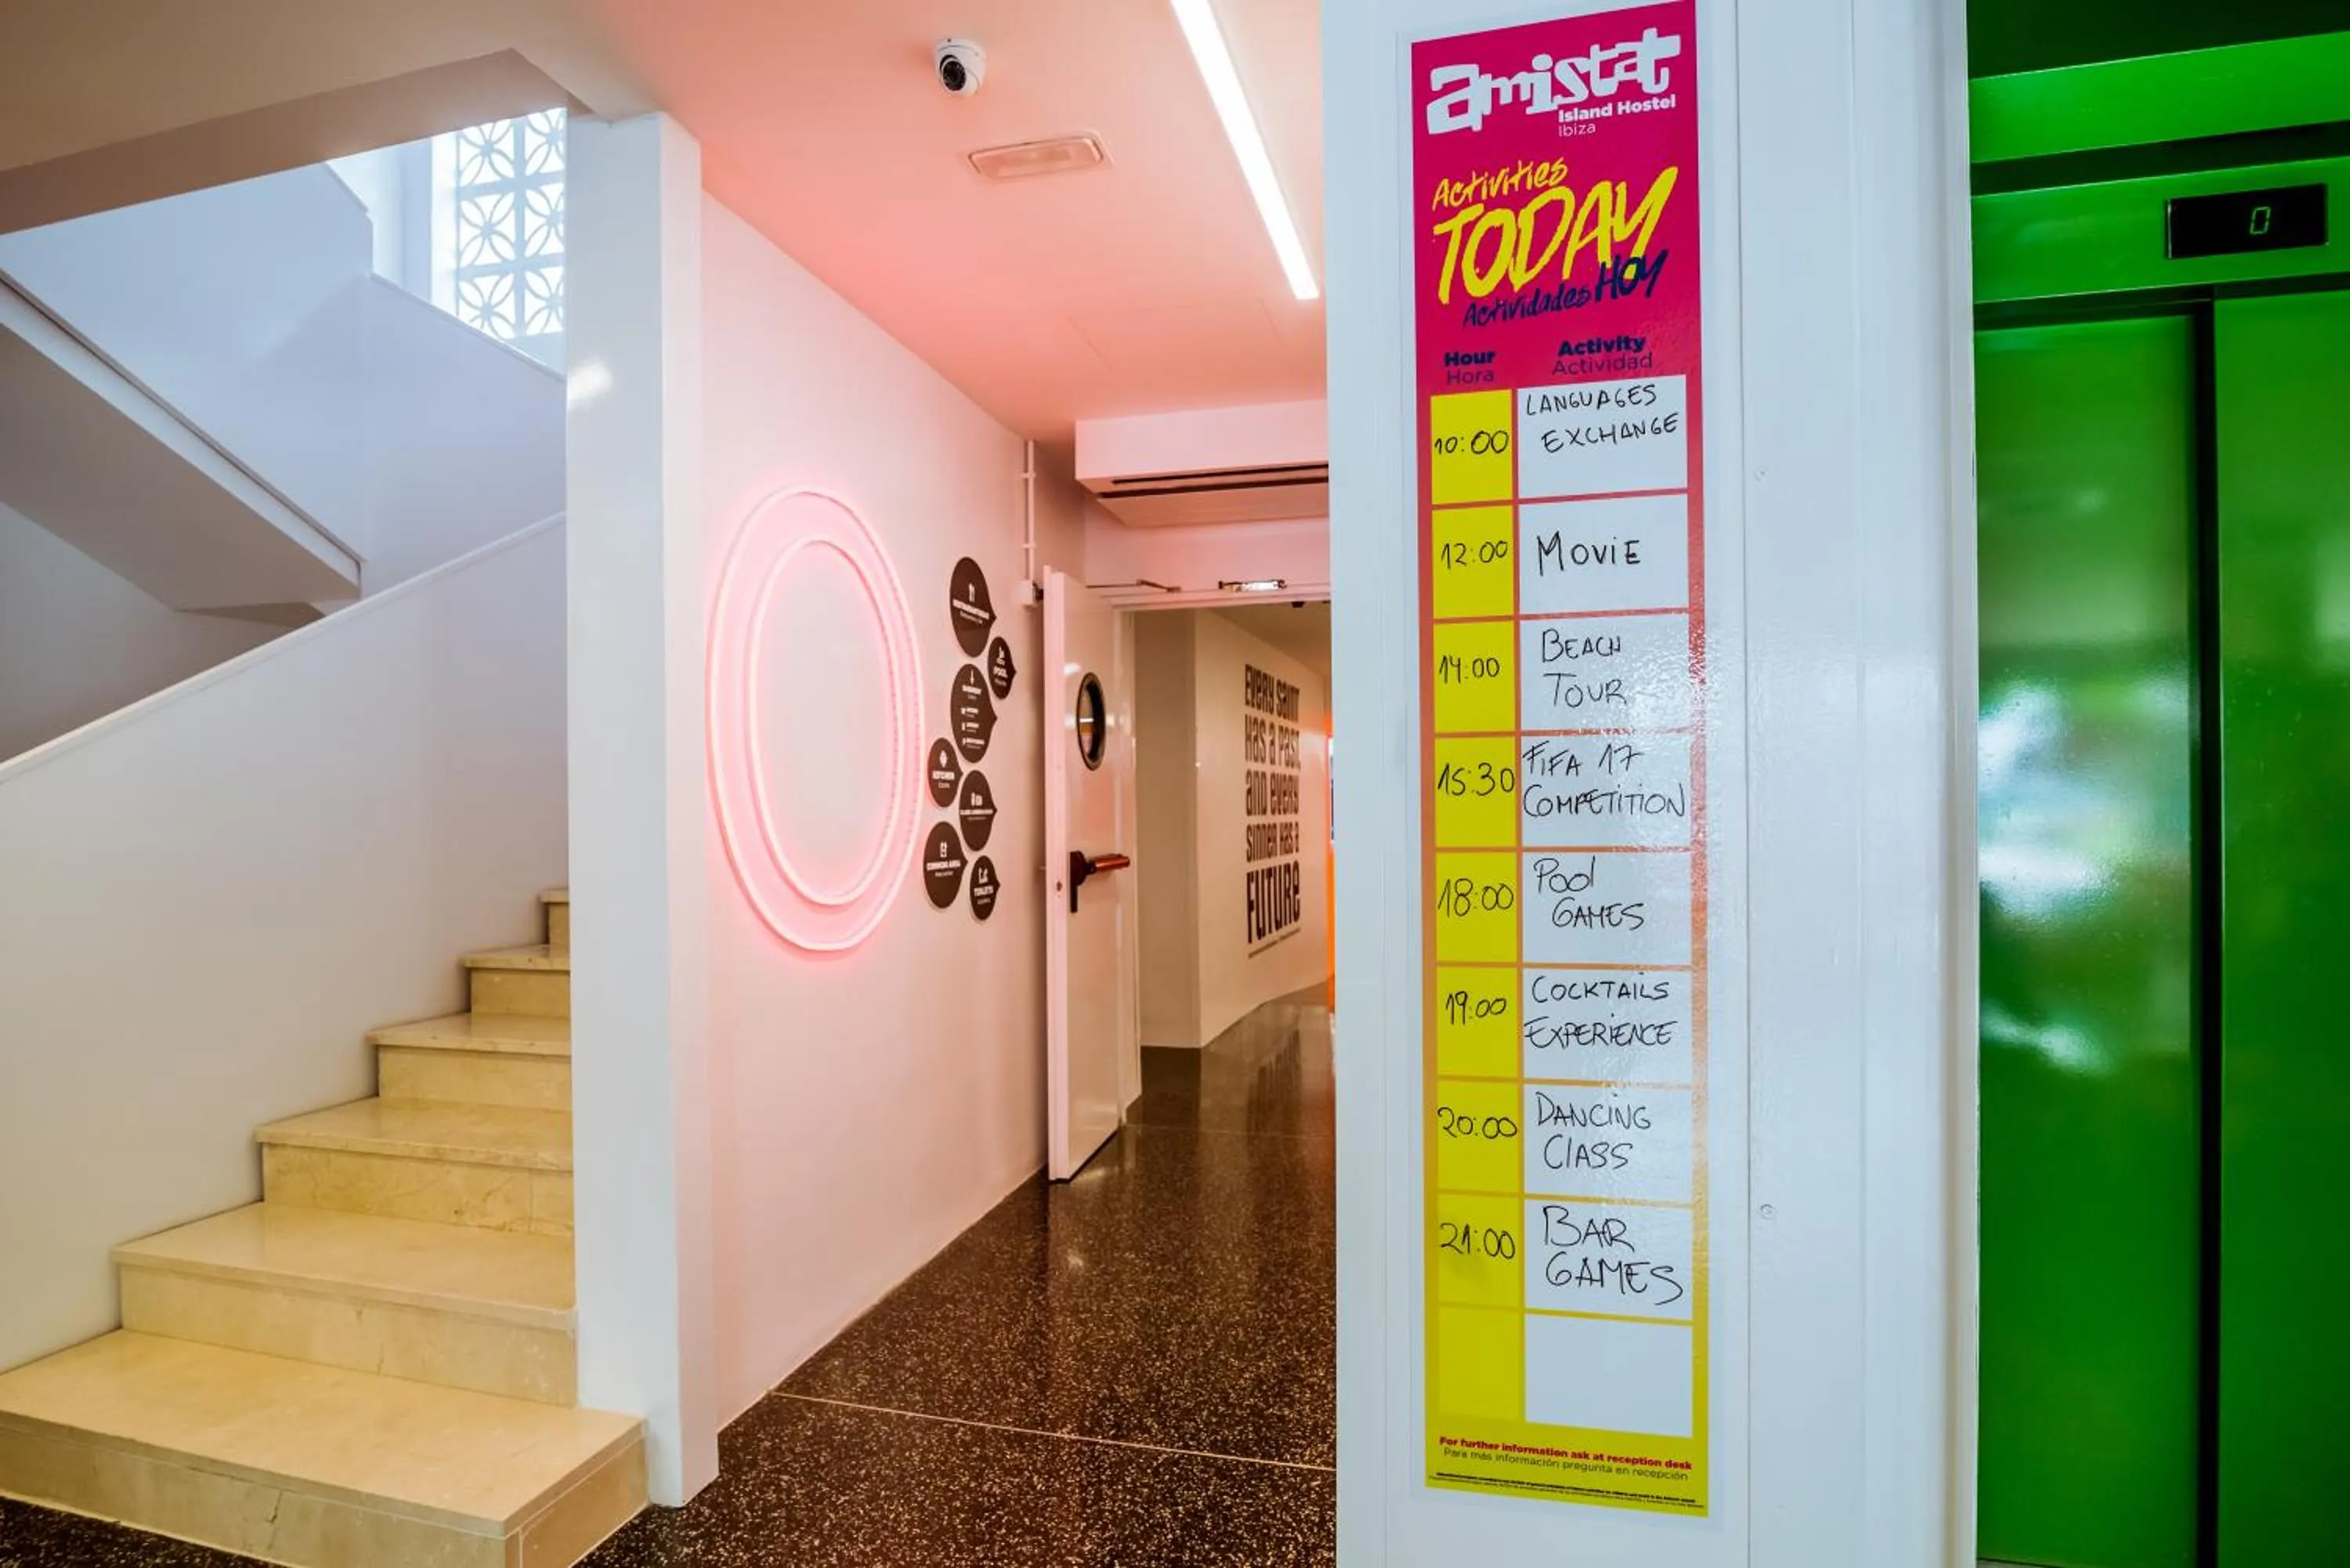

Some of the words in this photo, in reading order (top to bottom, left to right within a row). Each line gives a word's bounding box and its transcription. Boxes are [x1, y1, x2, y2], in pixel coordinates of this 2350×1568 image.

[1426, 27, 1681, 135] amistat
[1558, 103, 1613, 123] Island
[1618, 94, 1676, 116] Hostel
[1558, 123, 1596, 138] Ibiza
[1432, 157, 1568, 211] Activities
[1433, 165, 1679, 305] TODAY
[2249, 205, 2271, 235] 0
[1462, 283, 1592, 327] Actividades
[1594, 248, 1668, 302] HOY
[1444, 350, 1495, 367] Hour
[1558, 335, 1647, 357] Activity
[1447, 369, 1495, 386] Hora
[1553, 352, 1654, 376] Actividad
[1527, 384, 1657, 416] LANGUAGES
[1434, 430, 1509, 455] 10:00
[1541, 412, 1679, 453] EXCHANGE
[1441, 540, 1508, 570] 12:00
[1542, 627, 1622, 663] BEACH
[1542, 673, 1628, 708] TOUR
[1522, 740, 1583, 777] FIFA
[1598, 743, 1646, 775] 17
[1437, 762, 1516, 797] 15:30
[1437, 877, 1515, 918] 18:00
[1552, 896, 1645, 930] GAMES
[1437, 1107, 1518, 1140] 20:00
[1440, 1223, 1516, 1259] 21:00
[1542, 1205, 1635, 1253] BAR
[1546, 1251, 1683, 1306] GAMES
[1439, 1436, 1458, 1446] For
[1460, 1438, 1499, 1451] further
[1502, 1443, 1567, 1458] information
[1570, 1451, 1590, 1460] ask
[1607, 1455, 1662, 1467] reception
[1665, 1459, 1693, 1470] desk
[1444, 1447, 1467, 1458] Para
[1470, 1451, 1492, 1461] más
[1495, 1453, 1560, 1468] información
[1562, 1461, 1613, 1475] pregunta
[1616, 1467, 1630, 1476] en
[1632, 1469, 1689, 1482] recepción
